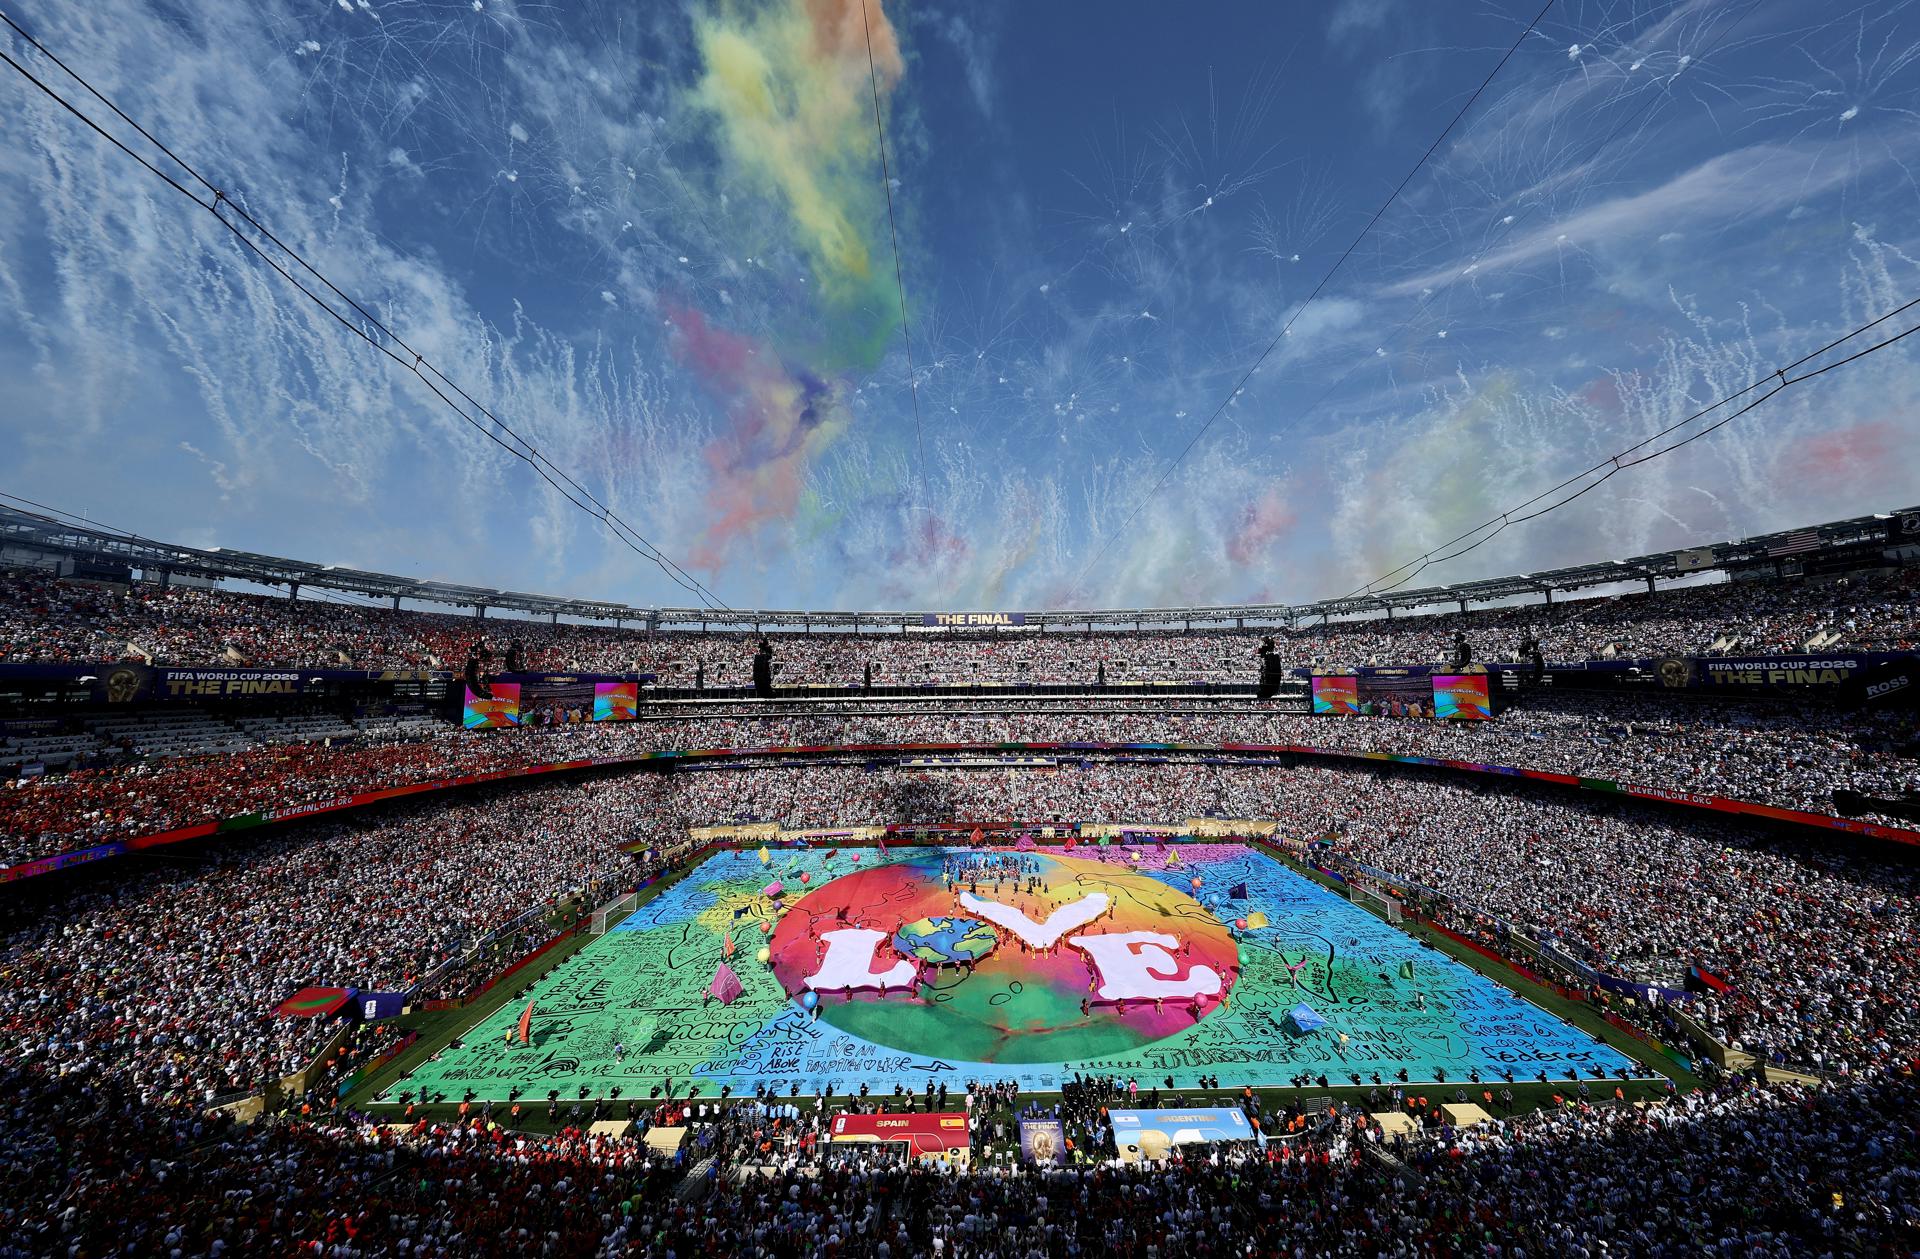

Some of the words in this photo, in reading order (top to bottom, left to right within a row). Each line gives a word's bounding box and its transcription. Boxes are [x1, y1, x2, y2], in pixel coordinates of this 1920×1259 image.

[935, 614, 965, 625] THE
[968, 614, 1013, 625] FINAL
[1708, 663, 1733, 671] FIFA
[1734, 662, 1778, 671] WORLD
[1780, 661, 1807, 670] CUP
[1809, 660, 1858, 669] 2026
[167, 672, 194, 680] FIFA
[196, 672, 238, 681] WORLD
[240, 673, 262, 681] CUP
[262, 673, 299, 681] 2026
[1710, 670, 1764, 684] THE
[166, 680, 222, 695] THE
[226, 680, 298, 694] FINAL
[1866, 675, 1909, 696] ROSS
[1616, 783, 1712, 805] BELIEVEINLOVE.ORG
[876, 1119, 909, 1128] SPAIN
[1156, 1114, 1218, 1123] ARGENTINA
